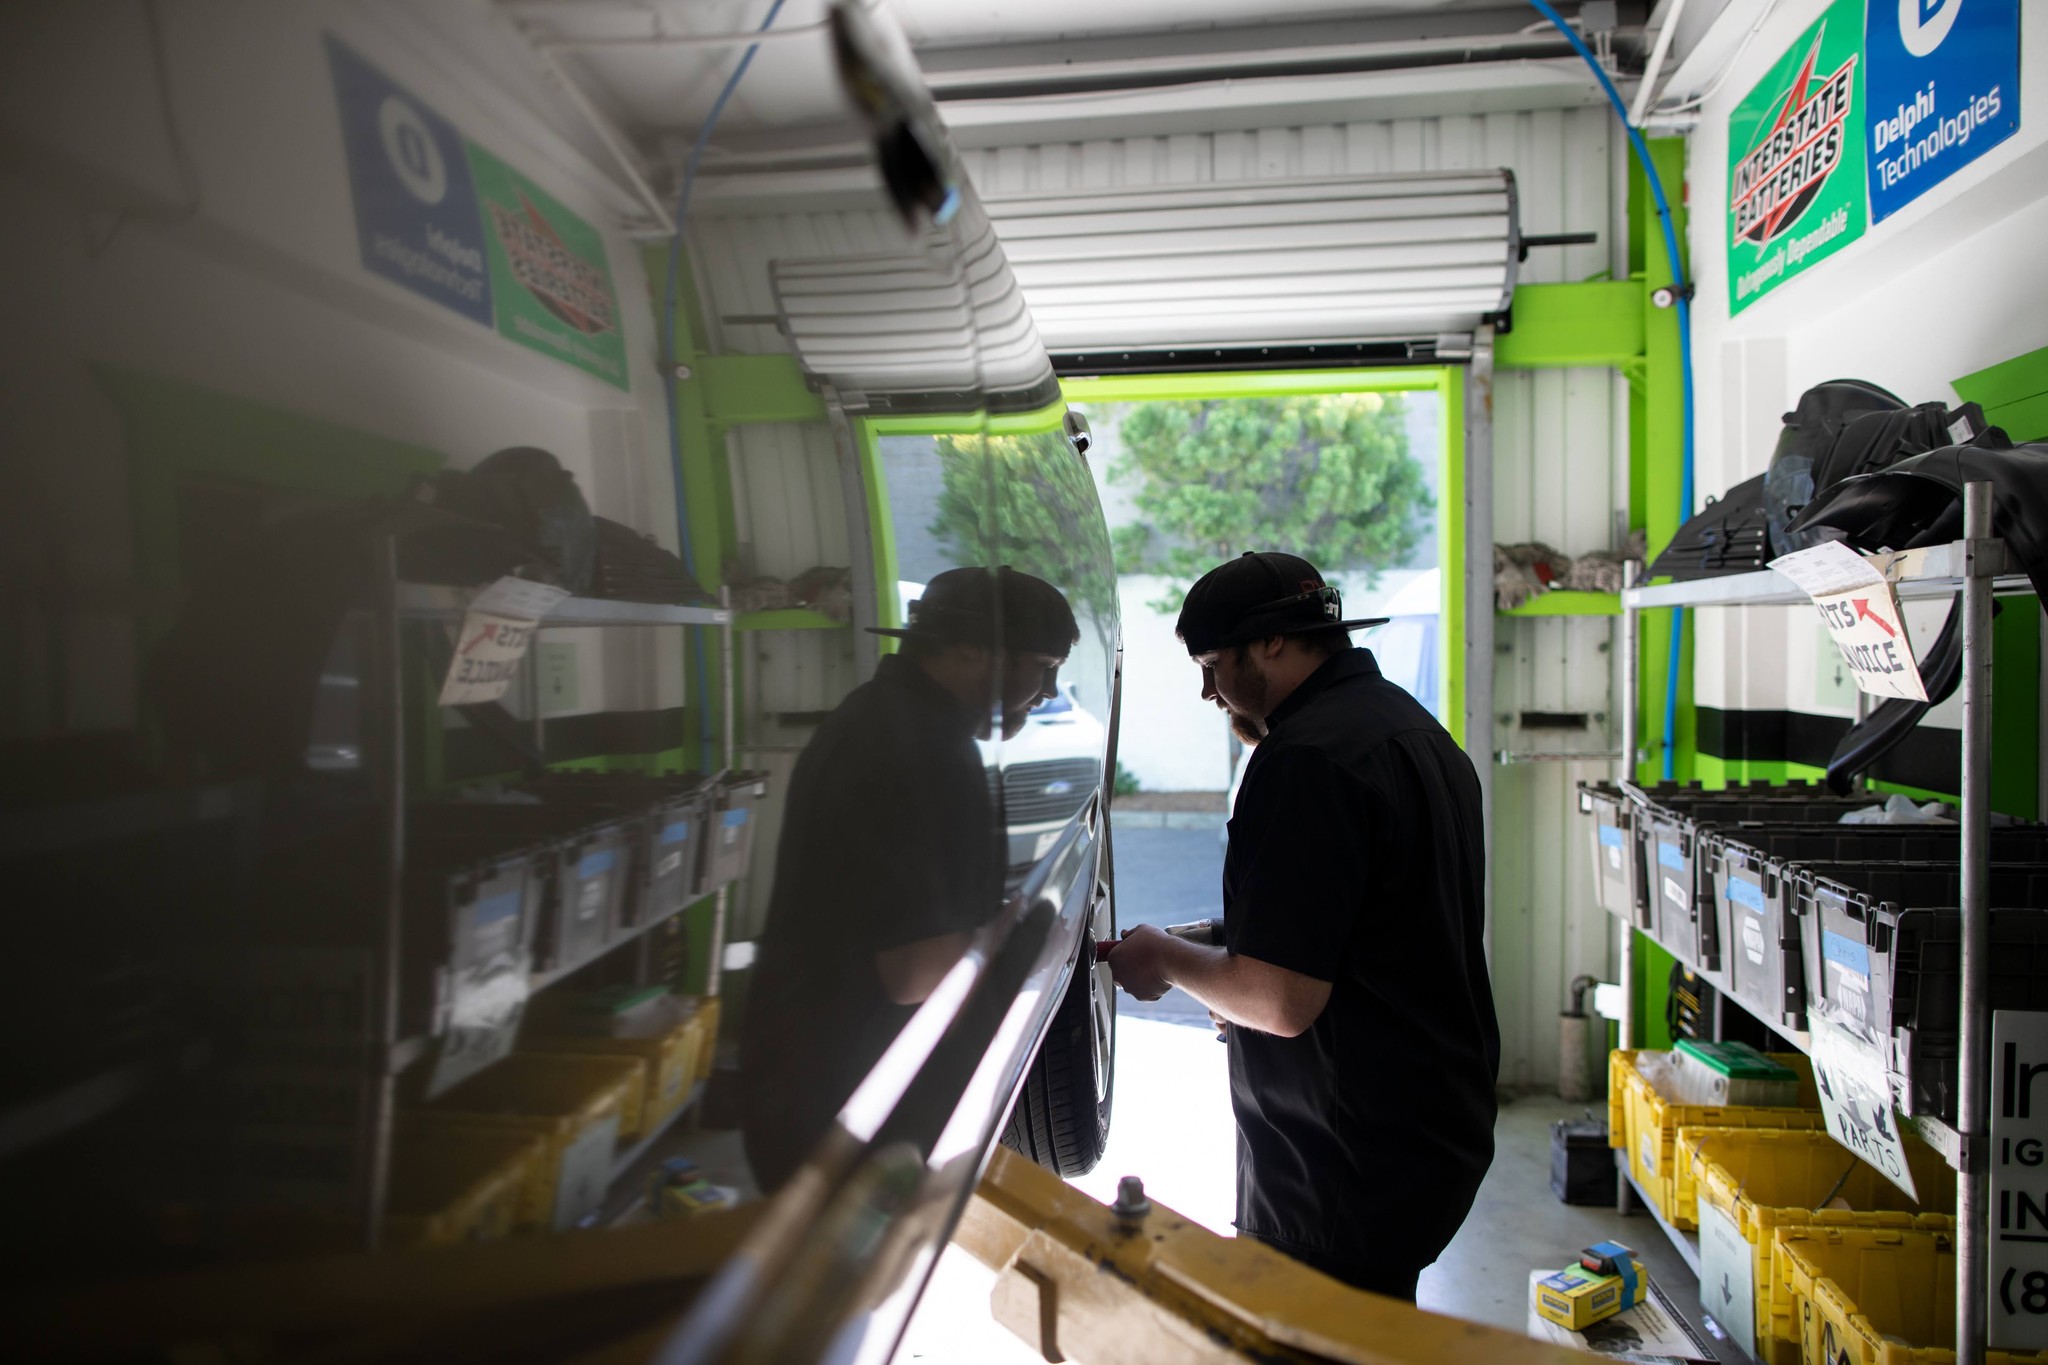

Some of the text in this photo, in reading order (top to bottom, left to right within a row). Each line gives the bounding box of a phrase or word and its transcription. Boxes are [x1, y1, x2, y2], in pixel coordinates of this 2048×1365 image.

[1735, 72, 1848, 199] INTERSTATE
[1874, 80, 1935, 154] Delphi
[1876, 84, 2001, 192] Technologies
[1737, 125, 1839, 234] BATTERIES
[1838, 1113, 1900, 1178] PARTS
[2002, 1137, 2044, 1166] IG
